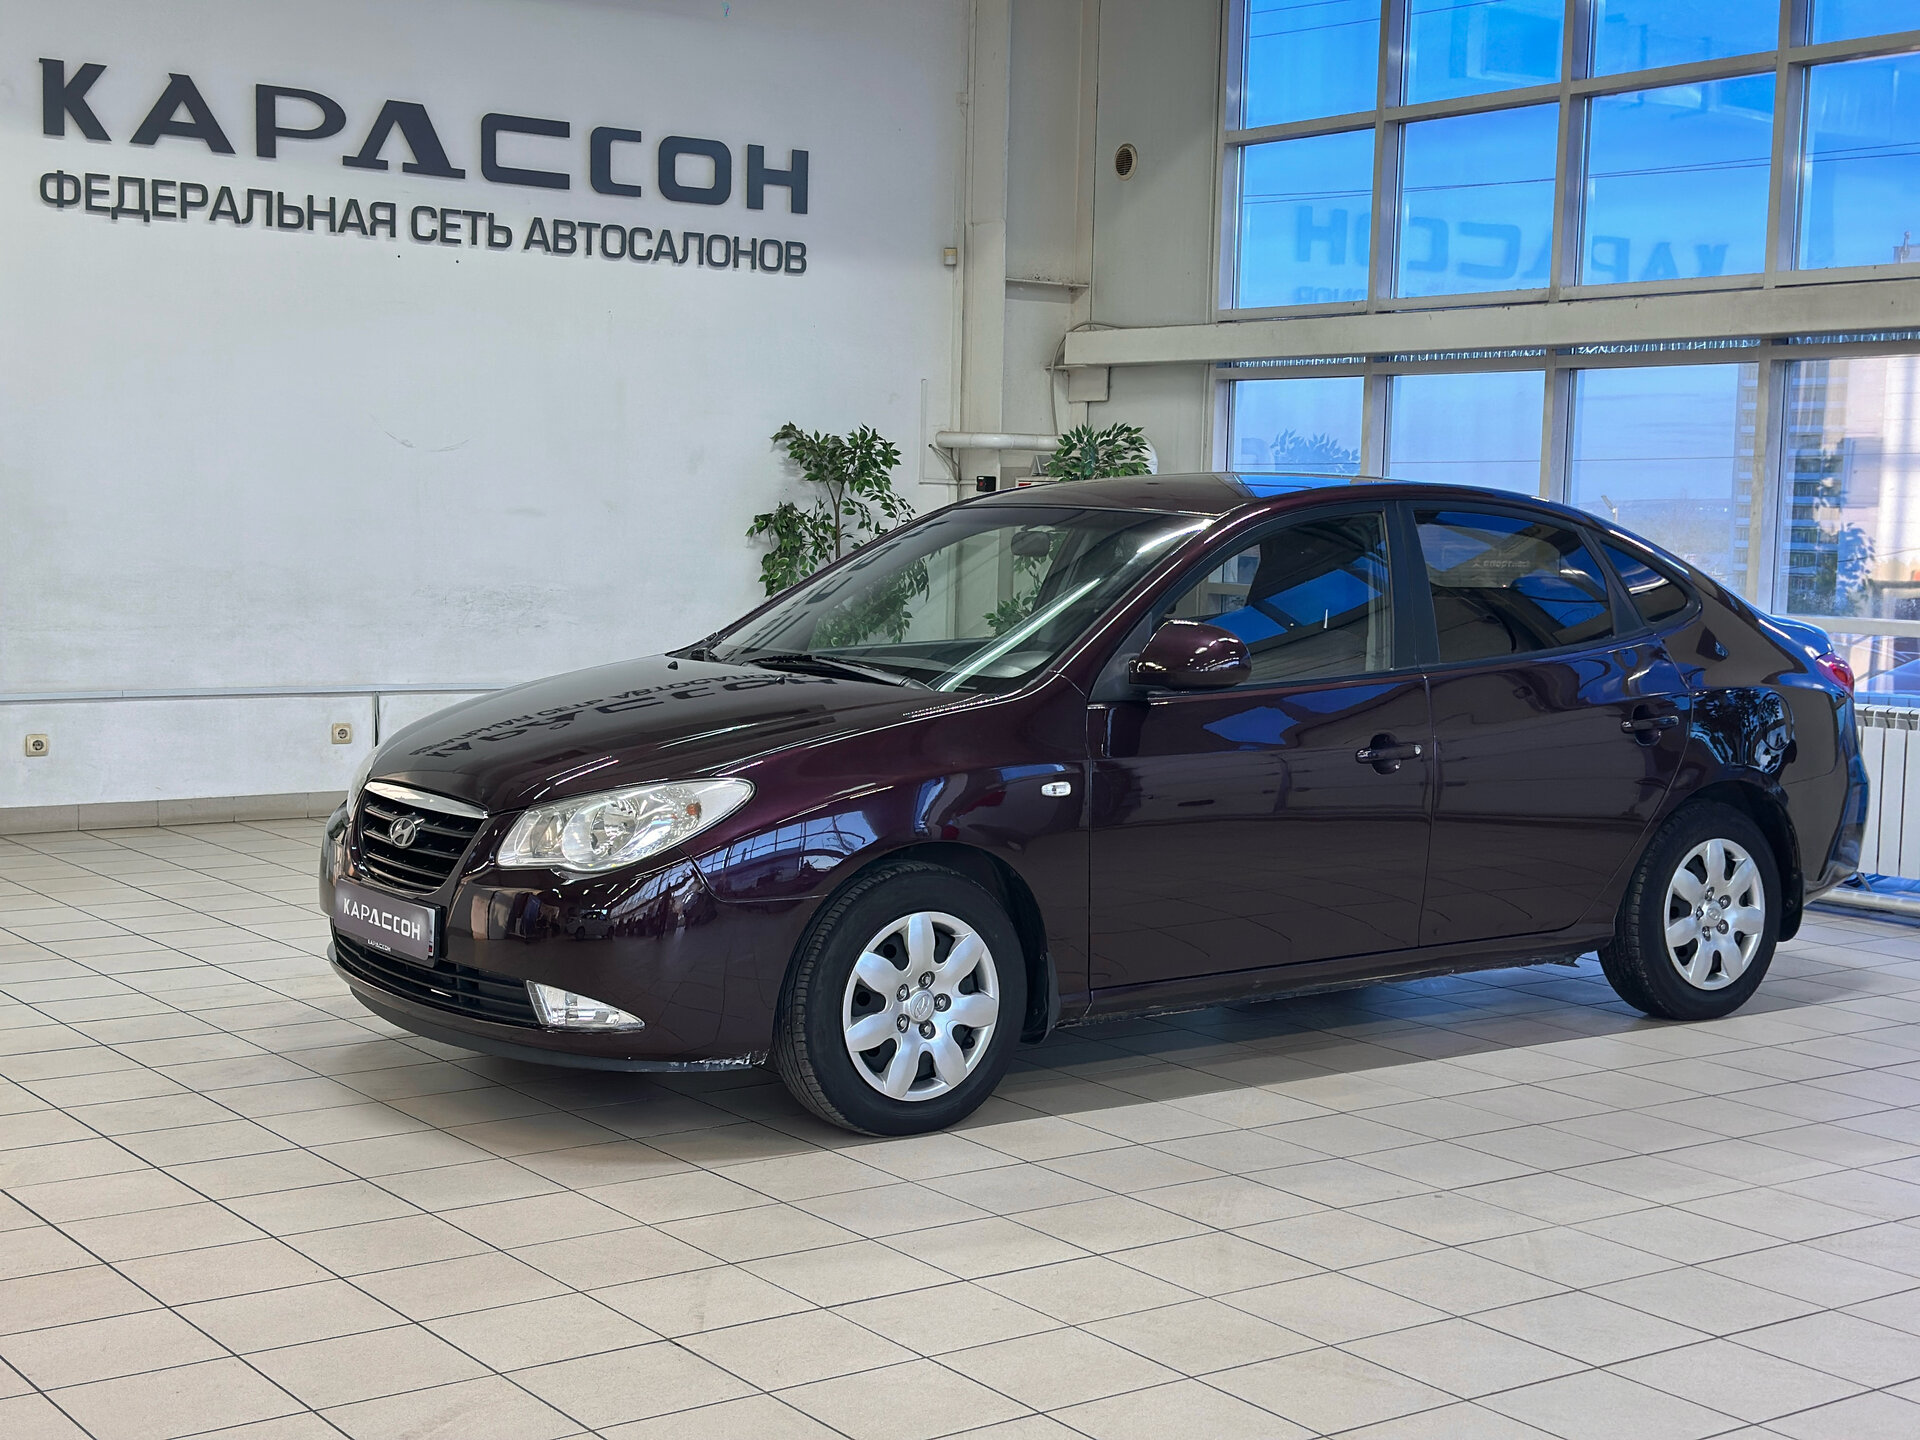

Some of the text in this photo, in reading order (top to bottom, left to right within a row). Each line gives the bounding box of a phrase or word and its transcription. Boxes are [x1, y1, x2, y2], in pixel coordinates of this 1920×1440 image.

[38, 57, 809, 215] КАРЛССОН
[39, 169, 807, 274] ФЕДЕРАЛЬНАЯ СЕТЬ АВТОСАЛОНОВ
[343, 897, 421, 941] КАРЛССОН
